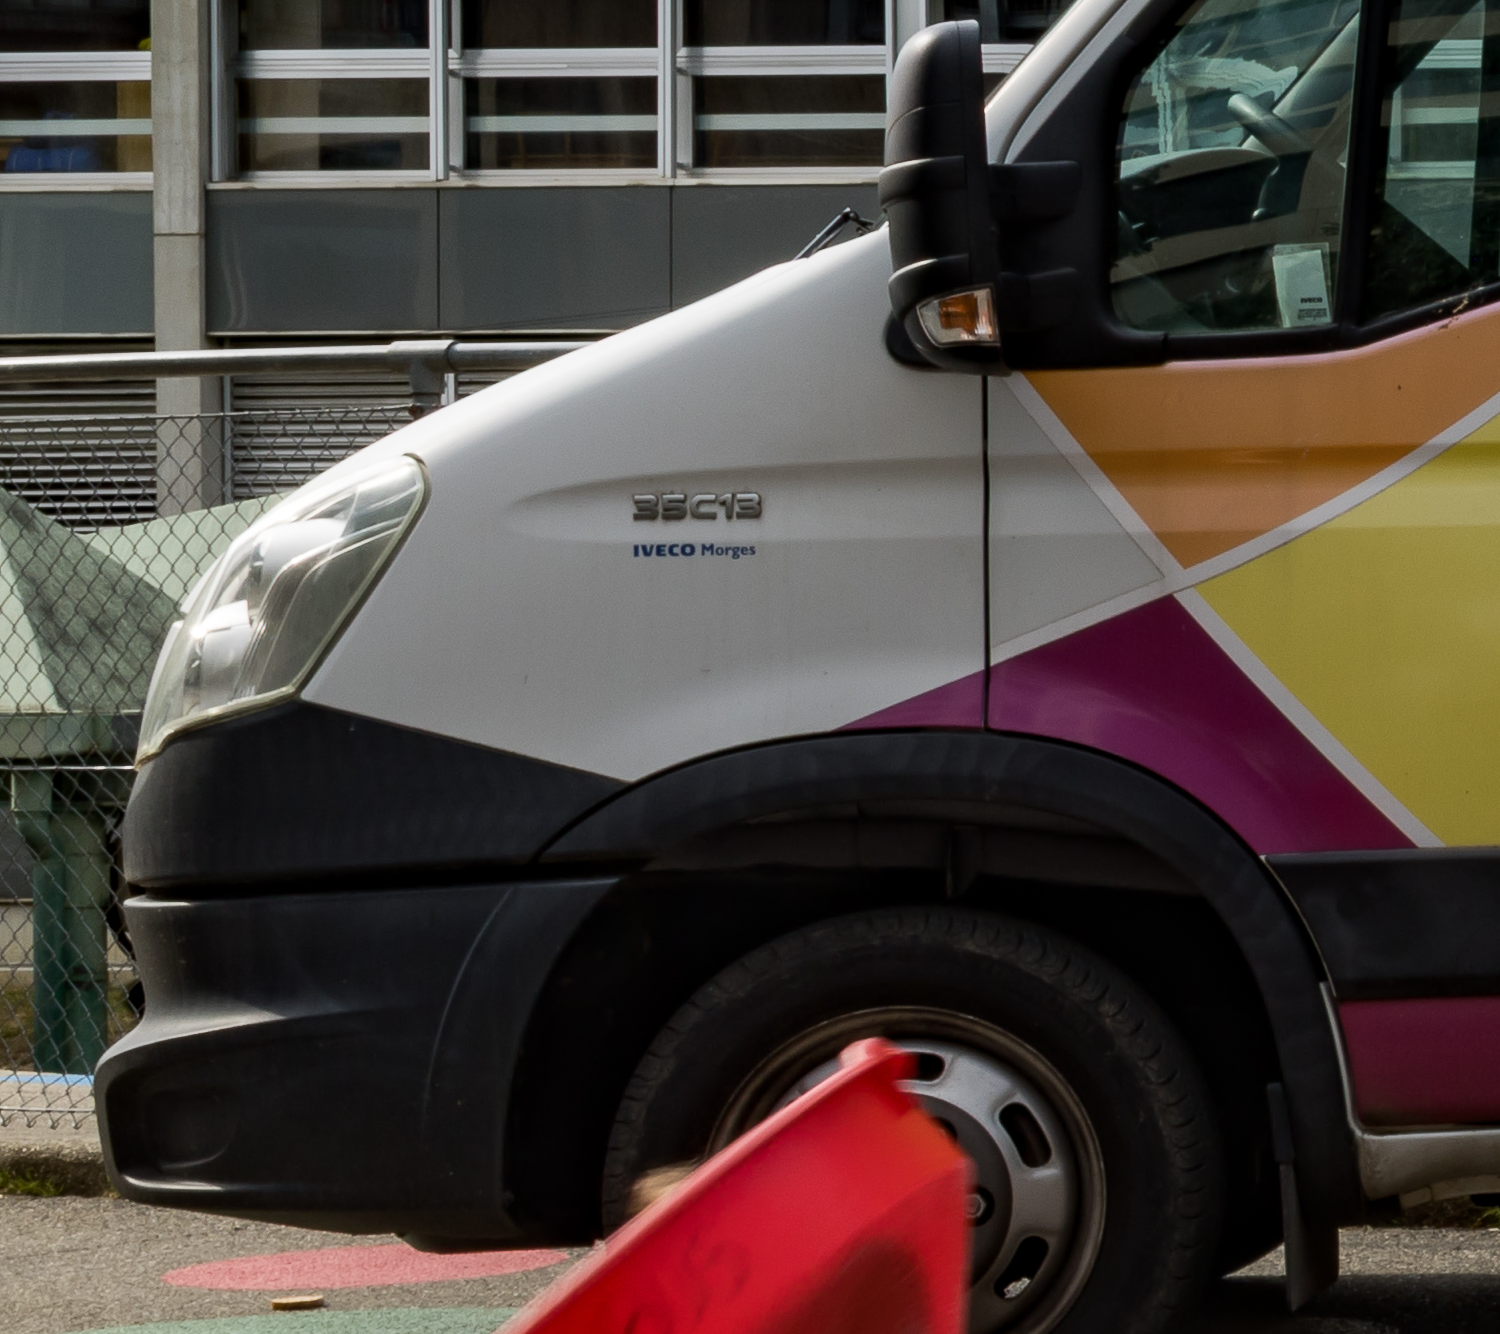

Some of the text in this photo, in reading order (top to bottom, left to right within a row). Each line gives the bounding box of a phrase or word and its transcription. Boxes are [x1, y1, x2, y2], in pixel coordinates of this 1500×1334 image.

[631, 491, 763, 522] 35C13
[632, 543, 757, 560] IVECO Morges
